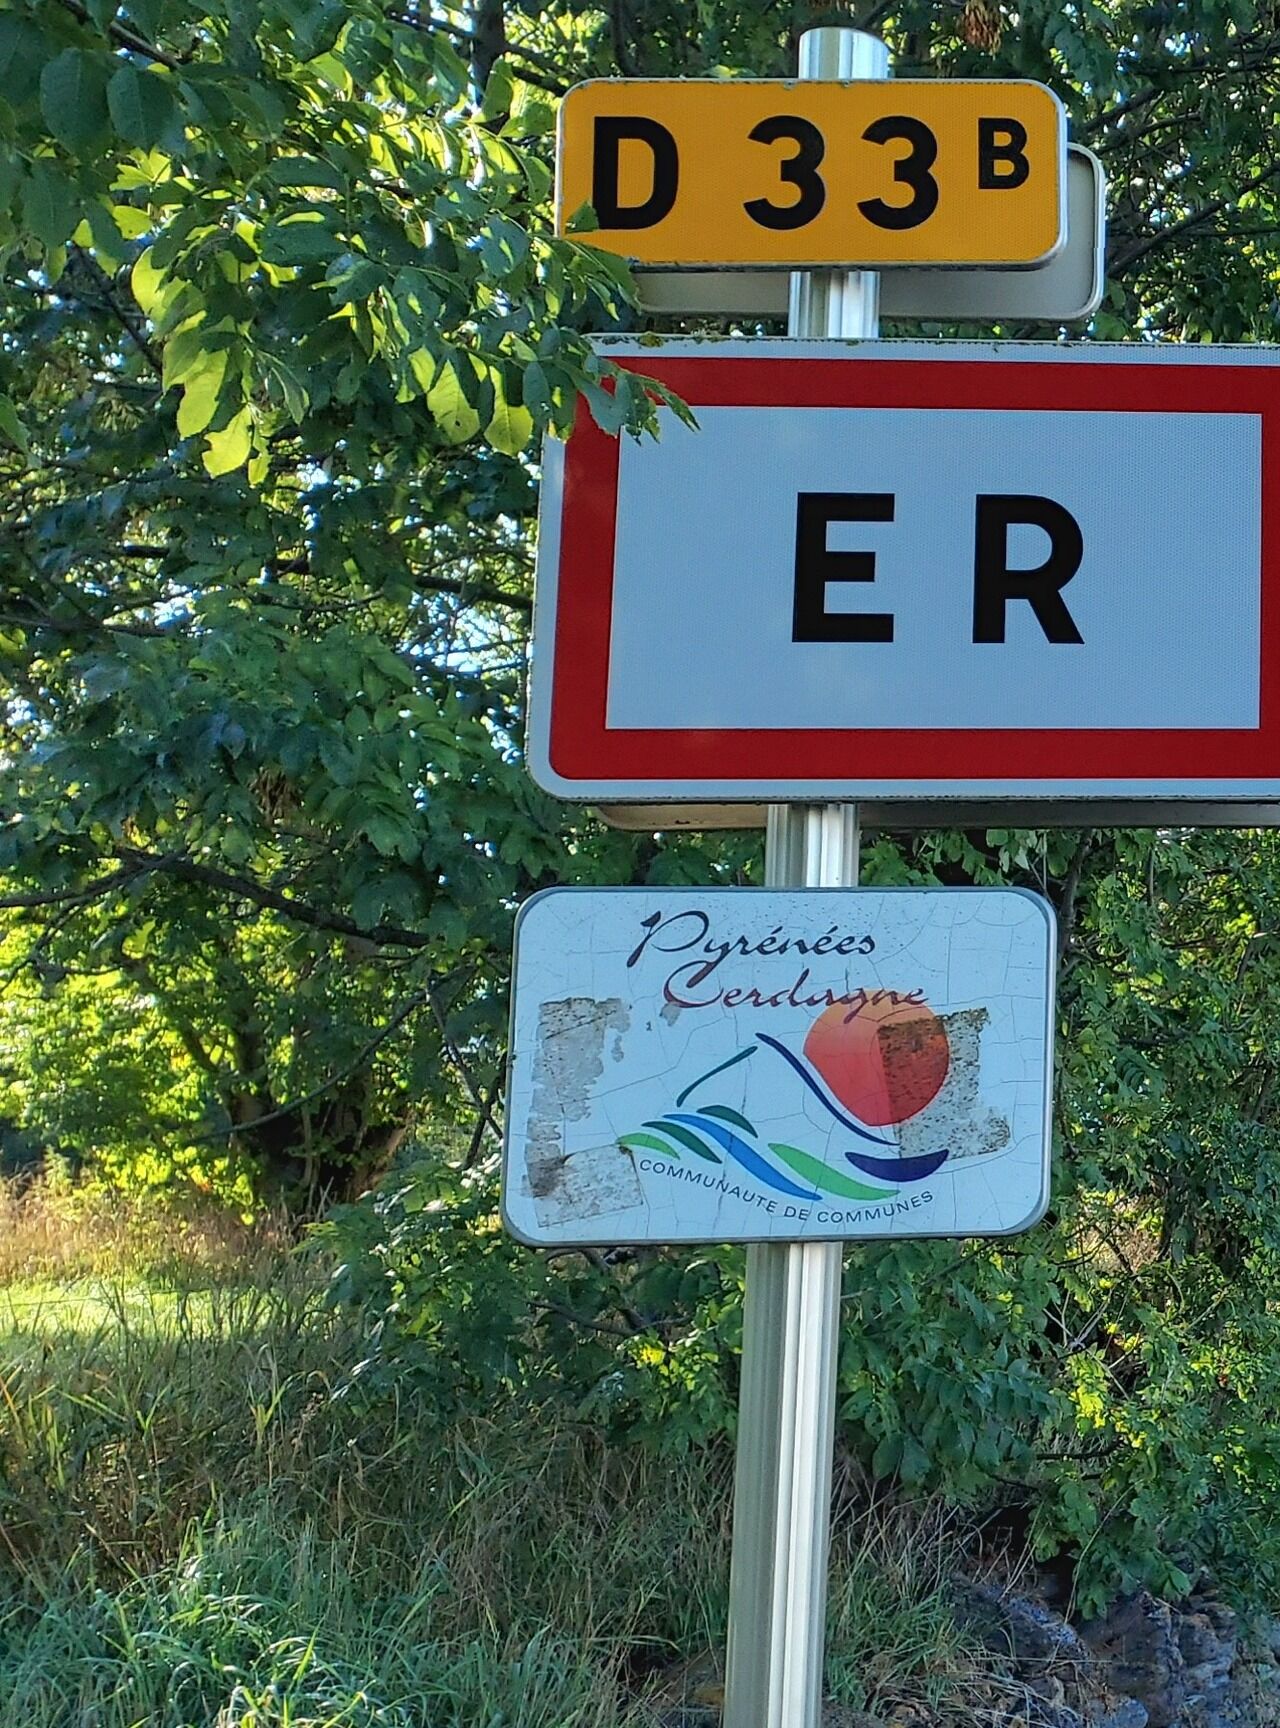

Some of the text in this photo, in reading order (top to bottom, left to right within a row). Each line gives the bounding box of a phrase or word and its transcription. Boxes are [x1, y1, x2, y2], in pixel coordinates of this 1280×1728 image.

[591, 115, 680, 231] D
[791, 491, 1085, 645] ER
[626, 909, 876, 989] Pyrénées
[663, 960, 929, 1024] Cerdagne
[638, 1158, 935, 1225] COMMUNAUTE DE COMMUNES
